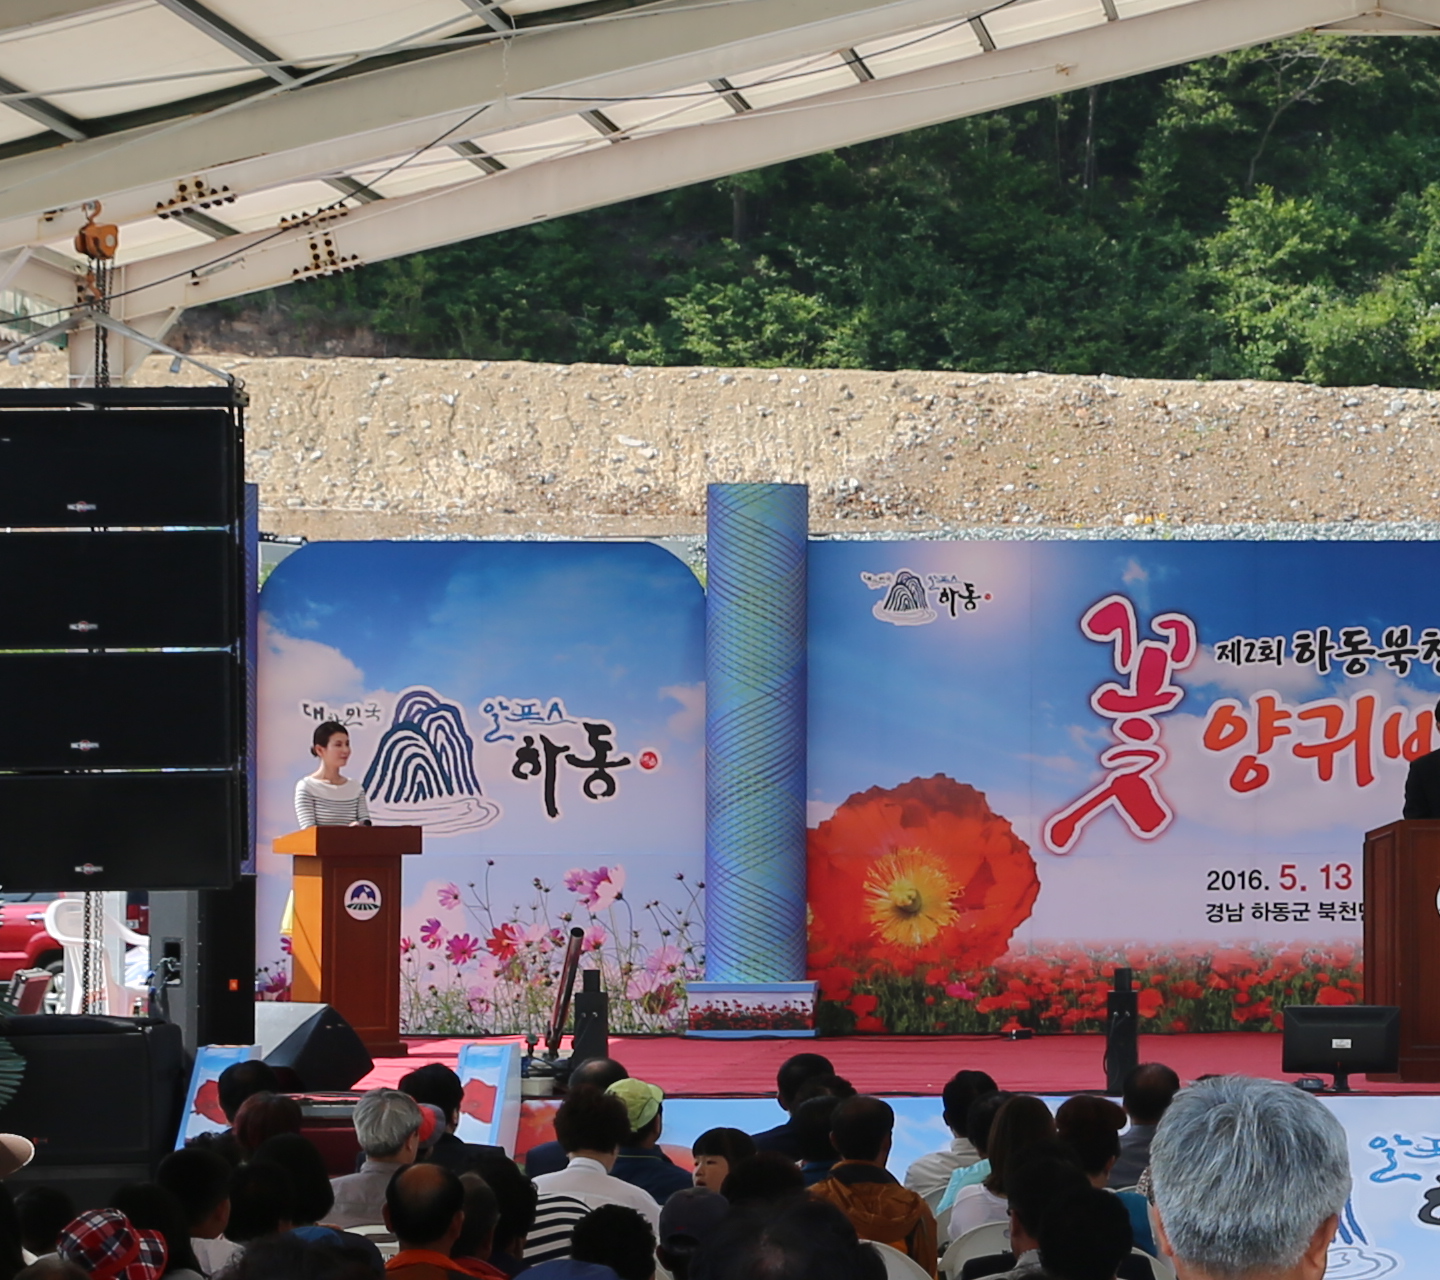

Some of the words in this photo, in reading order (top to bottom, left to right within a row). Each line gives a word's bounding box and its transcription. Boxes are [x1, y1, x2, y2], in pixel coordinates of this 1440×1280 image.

[939, 583, 981, 617] 하동
[1215, 636, 1283, 666] 제2회
[483, 698, 577, 742] 알프스
[1048, 598, 1195, 851] 꽃
[512, 723, 630, 817] 하동
[1207, 870, 1270, 891] 2016.
[1279, 864, 1308, 892] 5.
[1320, 863, 1352, 890] 13
[1205, 902, 1243, 922] 경남
[1251, 902, 1311, 922] 하동군
